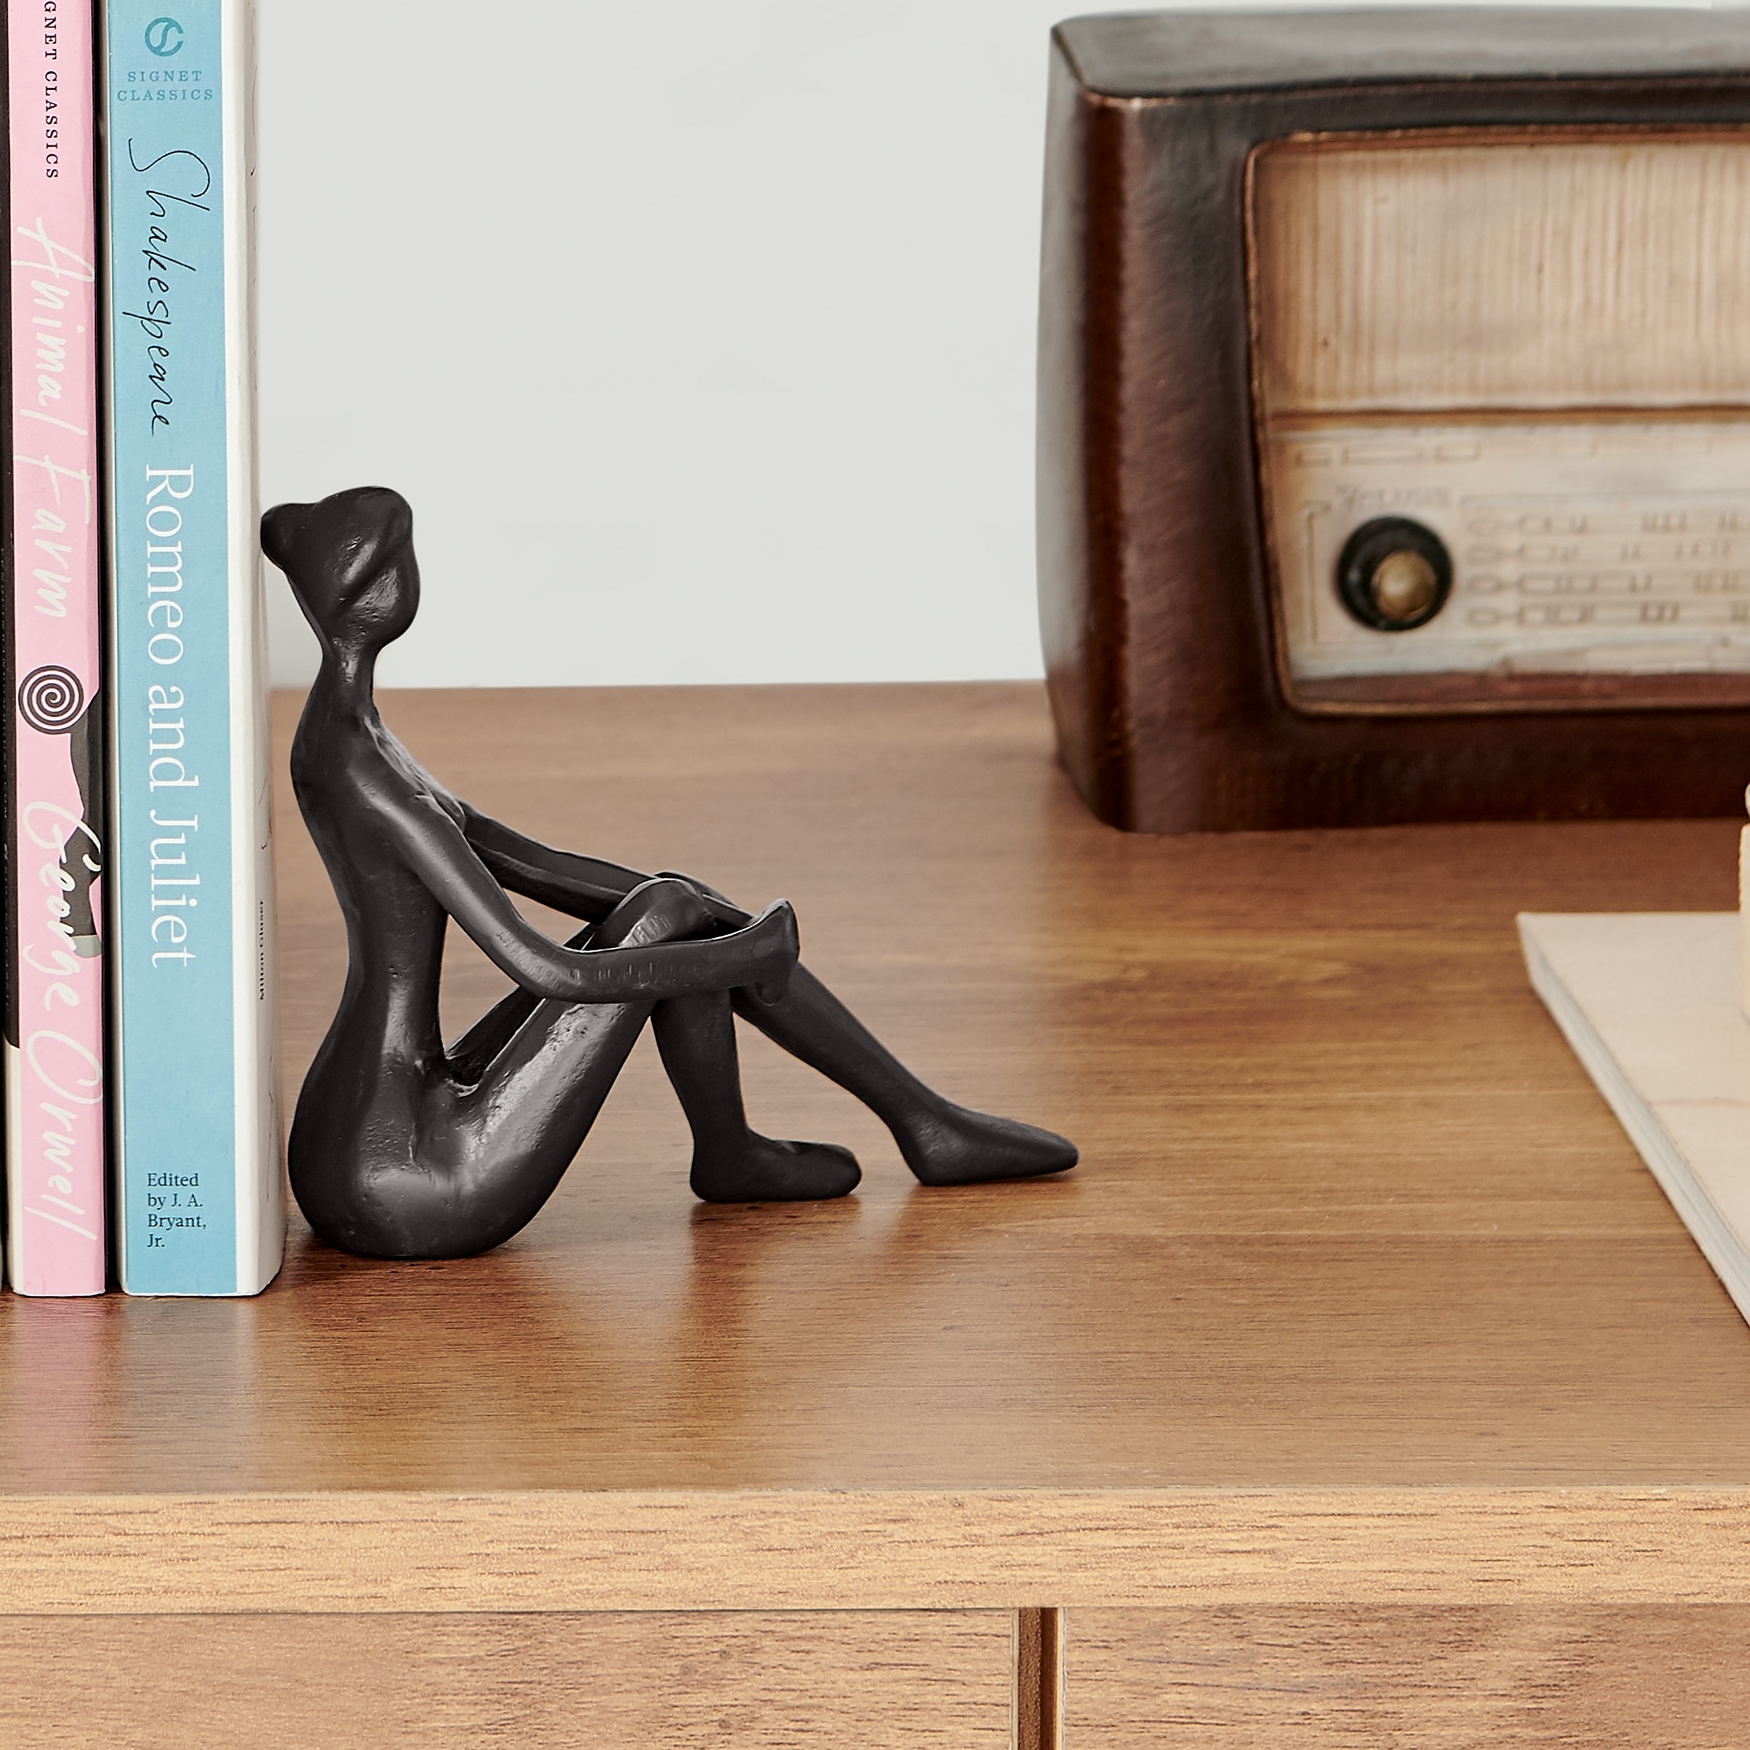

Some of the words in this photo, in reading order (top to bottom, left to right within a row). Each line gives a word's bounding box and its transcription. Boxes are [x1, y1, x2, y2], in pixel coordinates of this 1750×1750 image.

[45, 71, 59, 179] CLASSICS
[116, 88, 215, 102] CLASSICS
[126, 69, 204, 83] SIGNET
[10, 217, 96, 436] Animal
[122, 138, 211, 436] Shakespeare
[14, 454, 92, 619] Farm
[145, 463, 195, 666] Romeo
[148, 684, 200, 793] and
[22, 801, 103, 1012] George
[148, 810, 201, 969] Juliet
[24, 1029, 104, 1242] Orwell
[146, 1172, 199, 1188] Edited
[146, 1234, 166, 1249] Jr.
[147, 1193, 167, 1212] by
[171, 1193, 182, 1208] J.
[187, 1193, 203, 1208] A.
[147, 1214, 207, 1233] Bryant,
